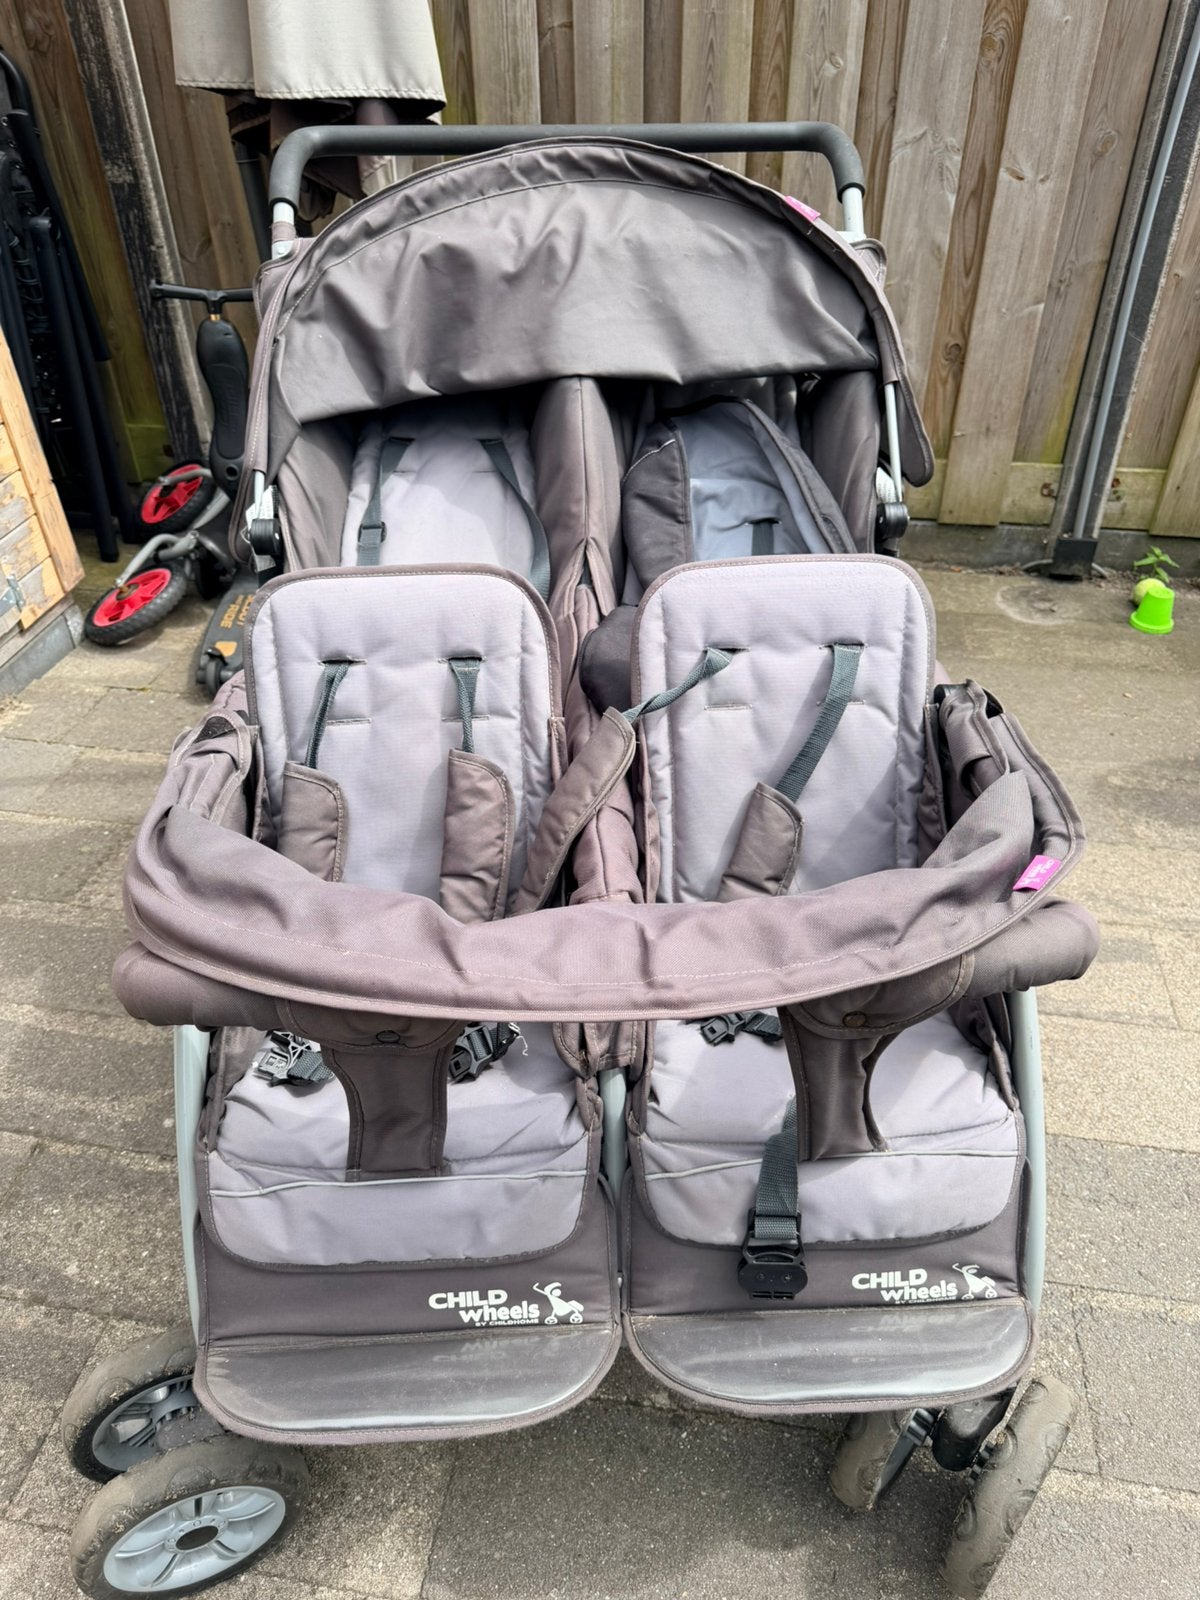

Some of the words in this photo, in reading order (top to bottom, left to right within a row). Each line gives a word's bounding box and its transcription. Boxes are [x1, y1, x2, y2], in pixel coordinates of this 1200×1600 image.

[851, 1268, 928, 1290] CHILD
[428, 1289, 508, 1310] CHILD
[880, 1280, 958, 1302] wheels
[459, 1300, 540, 1323] wheels
